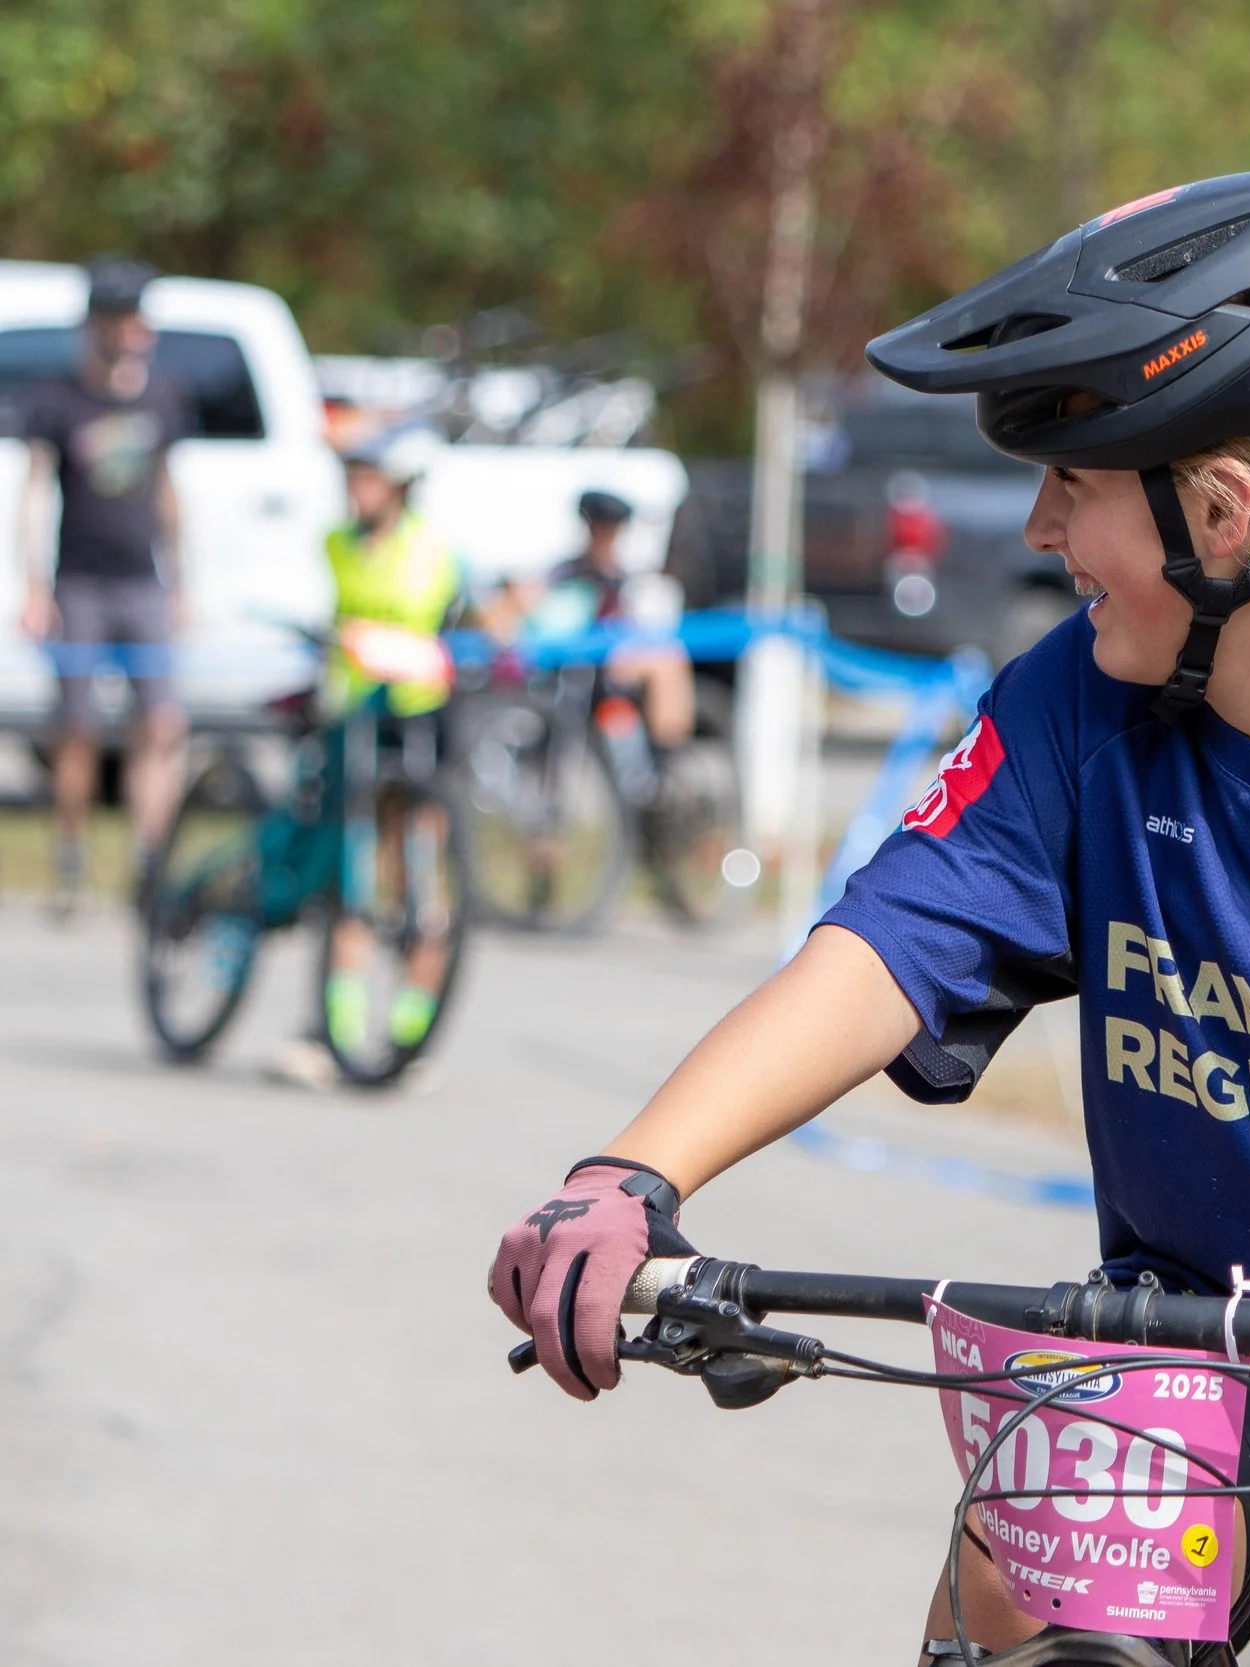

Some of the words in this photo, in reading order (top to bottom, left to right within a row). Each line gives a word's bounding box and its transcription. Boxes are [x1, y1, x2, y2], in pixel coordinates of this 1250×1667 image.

[1143, 330, 1207, 381] MAXXIS
[940, 1325, 984, 1373] NICA
[1153, 1372, 1224, 1401] 2025
[961, 1390, 1188, 1529] 5030
[1071, 1531, 1171, 1570] Wolfe
[1191, 1535, 1209, 1557] 1
[1007, 1558, 1095, 1594] TREK
[1159, 1585, 1217, 1597] pennsylvania
[1106, 1605, 1167, 1620] SHIMANO
